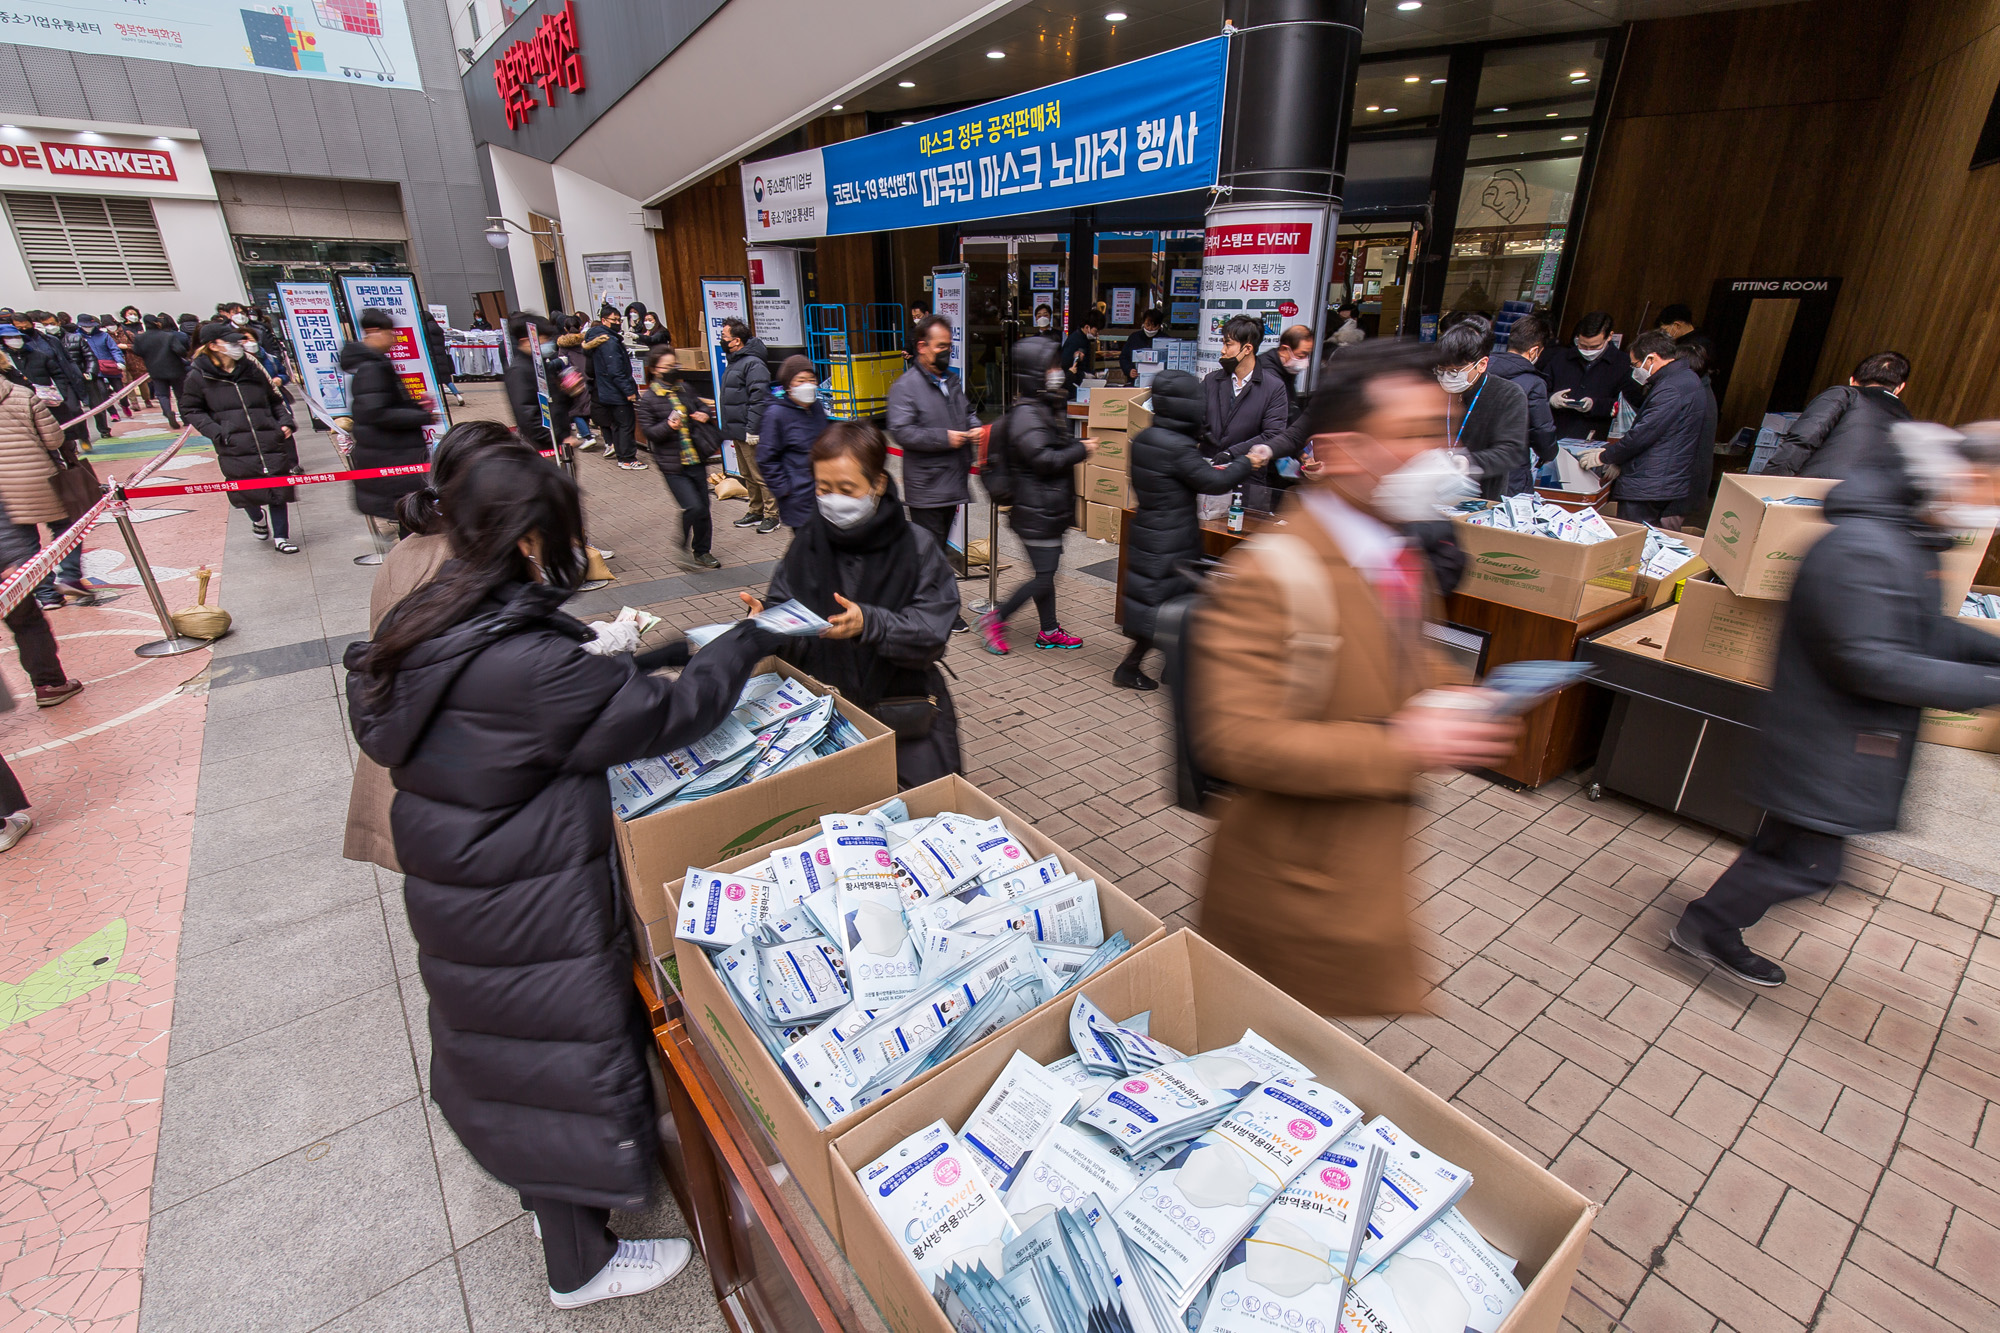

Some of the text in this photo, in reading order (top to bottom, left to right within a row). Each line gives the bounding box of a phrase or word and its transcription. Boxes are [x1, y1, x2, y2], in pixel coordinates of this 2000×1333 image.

[0, 11, 102, 35] 중소기업유통센터
[493, 0, 585, 130] 행복한백화점
[919, 100, 1061, 158] 마스크 정부 공적판매처
[49, 147, 171, 176] MARKER
[832, 111, 1199, 207] 코로나-19 확산방지 대국민 마스크 노마진 행사
[767, 172, 812, 196] 중소벤처기업부
[770, 206, 815, 226] 중소기업유통센터
[1221, 232, 1301, 248] 스탬프 EVENT
[1252, 264, 1286, 275] 적립가능
[356, 286, 403, 295] 대국민 마스크
[1215, 279, 1291, 292] 적립시 사은품 증정
[1732, 281, 1828, 291] FITTING ROOM
[363, 297, 402, 306] 노마진 행사
[296, 316, 331, 328] 대국민
[300, 328, 335, 340] 마스크
[304, 340, 338, 352] 노마진
[379, 464, 424, 476] 행복한백화점
[286, 473, 336, 485] 행복한백화점
[184, 482, 239, 494] 행복한백화점
[757, 885, 771, 919] 역용마스크
[792, 1052, 806, 1069] 크린웰
[851, 1047, 864, 1064] 크린웰
[1293, 1119, 1313, 1136] KF94
[1222, 1121, 1294, 1167] 황사방역용마스크
[1071, 1147, 1087, 1161] KOREA
[935, 1159, 956, 1178] KF94
[1091, 1161, 1106, 1174] MADE
[1434, 1166, 1459, 1181] 크린웰
[1325, 1170, 1347, 1183] KF94
[1283, 1187, 1350, 1210] eanwell
[1272, 1196, 1347, 1224] 방역용마스크
[911, 1192, 986, 1261] 황사방역용마스크
[1131, 1225, 1147, 1238] MADE
[1149, 1239, 1168, 1254] KOREA
